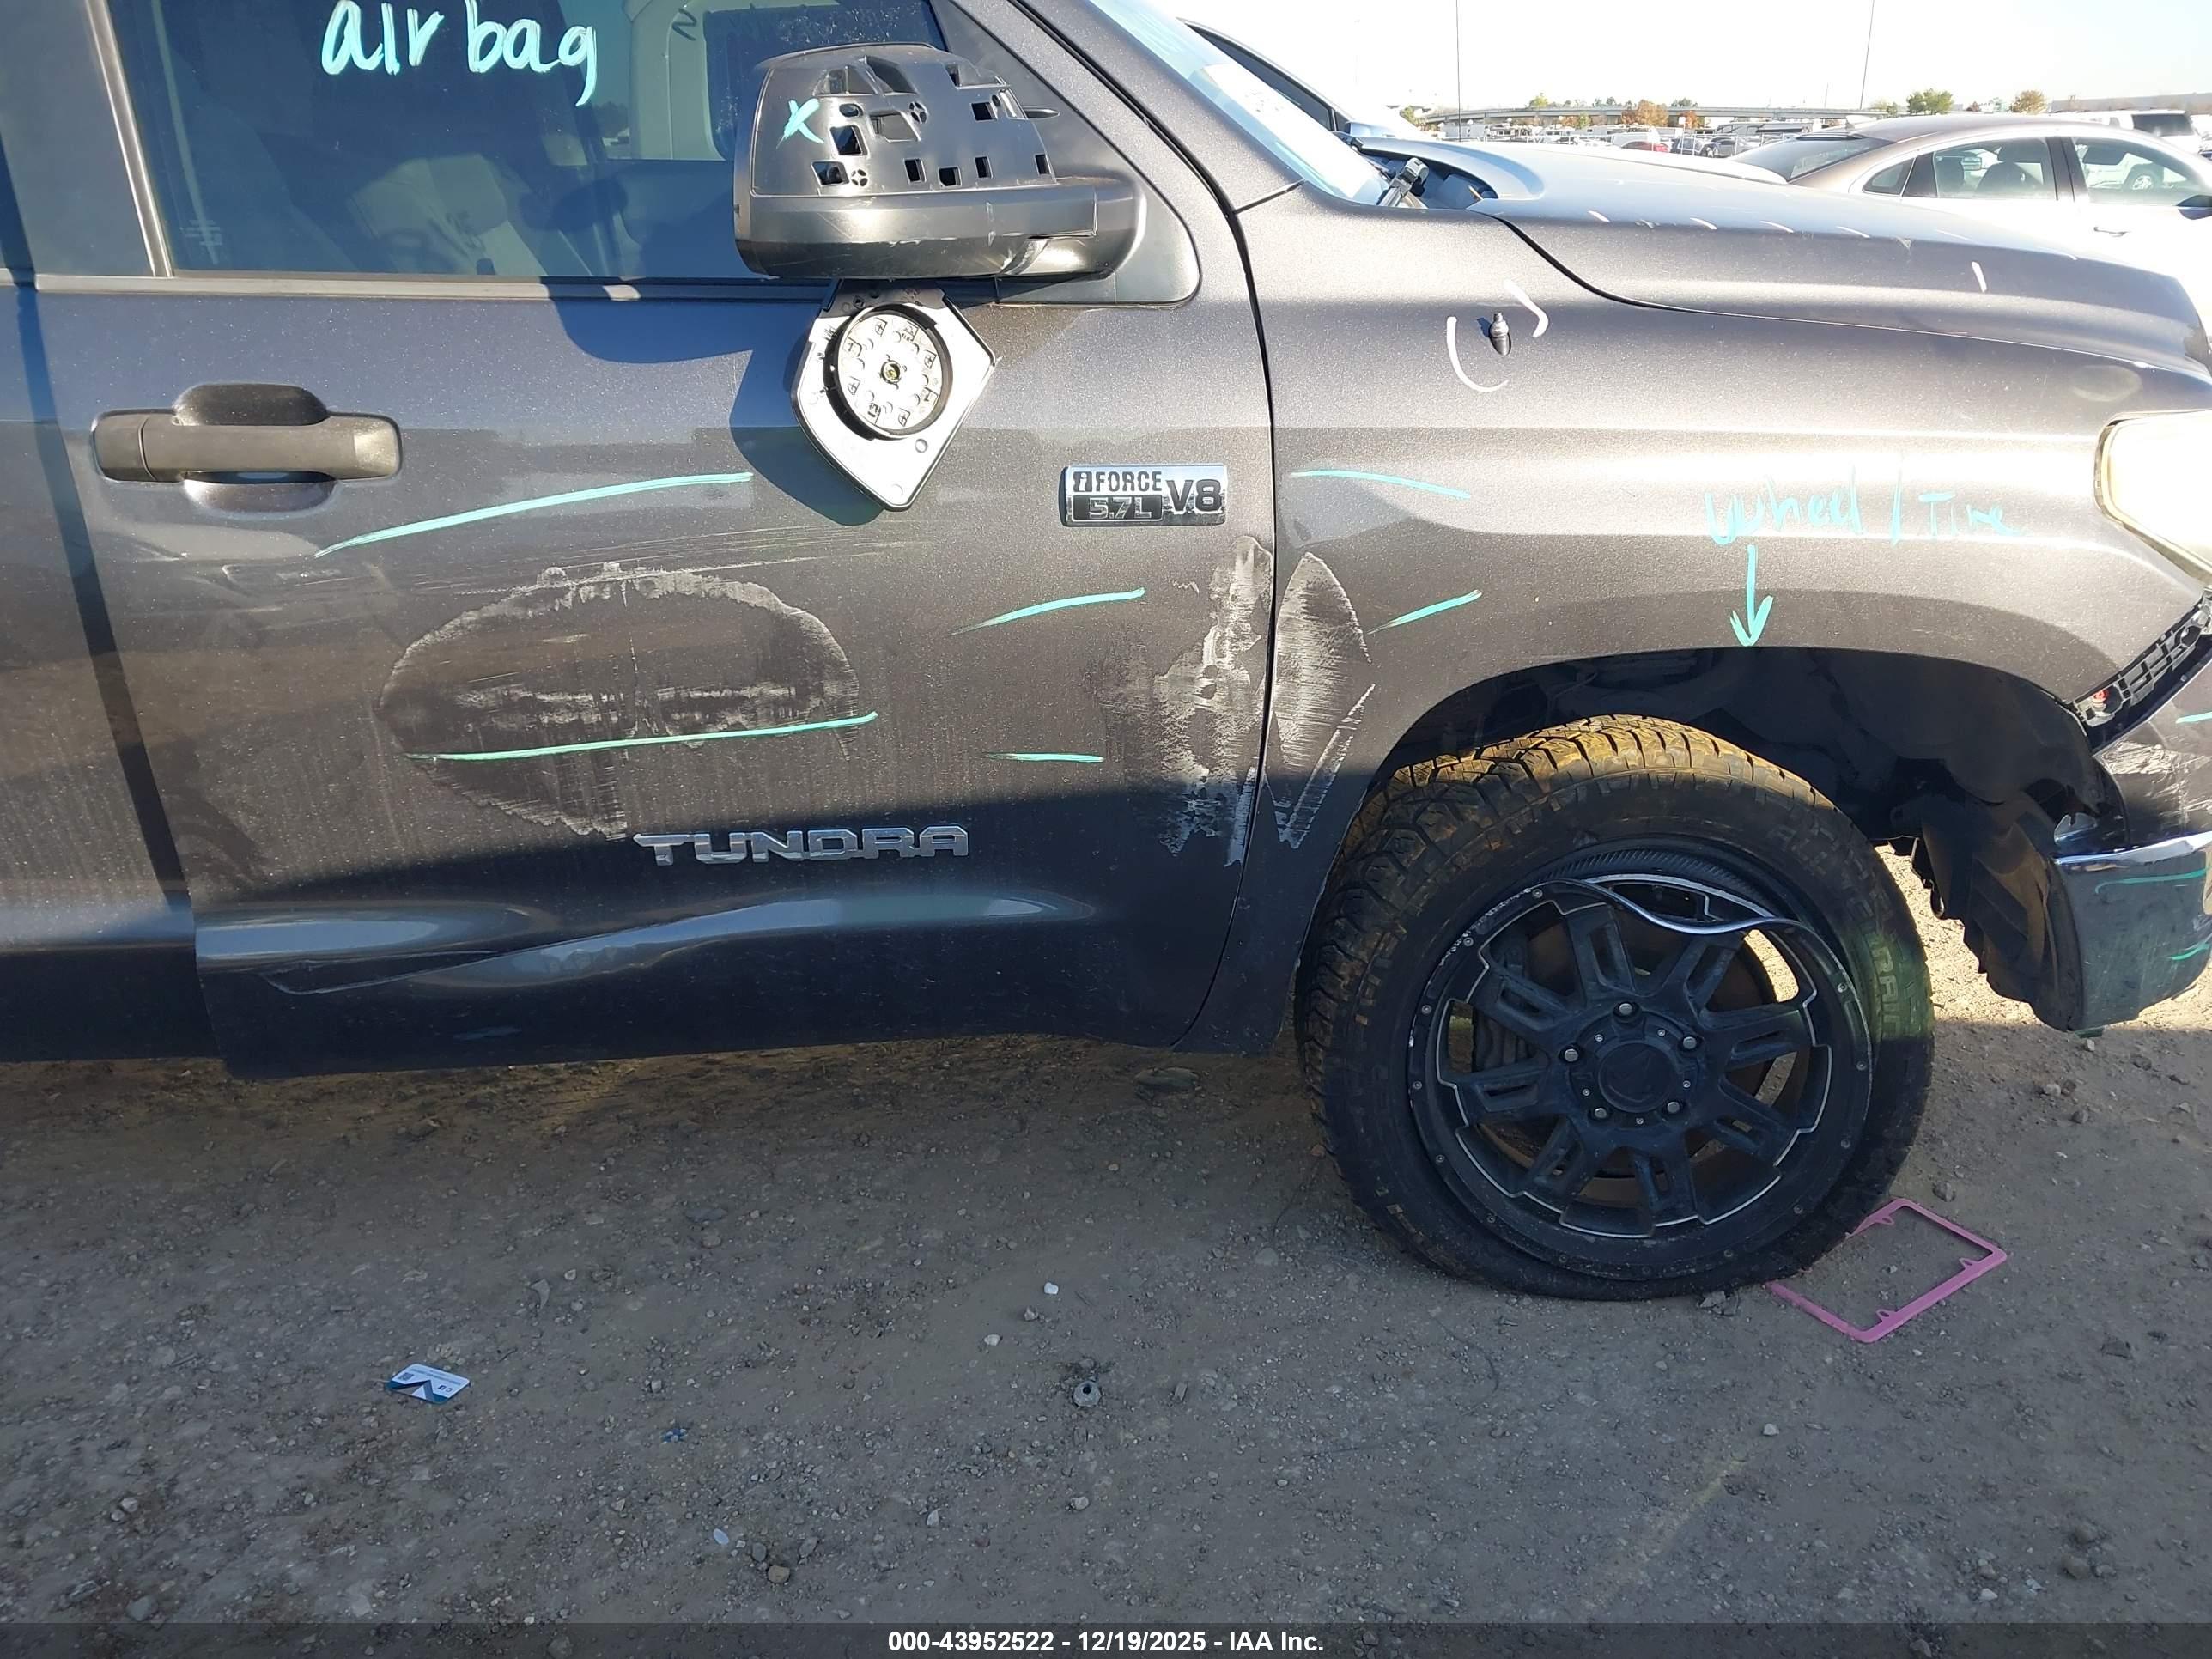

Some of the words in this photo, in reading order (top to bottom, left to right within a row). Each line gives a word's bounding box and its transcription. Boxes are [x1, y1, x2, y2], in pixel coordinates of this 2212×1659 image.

[1088, 495, 1152, 519] 5.7L
[1165, 478, 1223, 512] V8
[632, 825, 969, 866] TUNDRA
